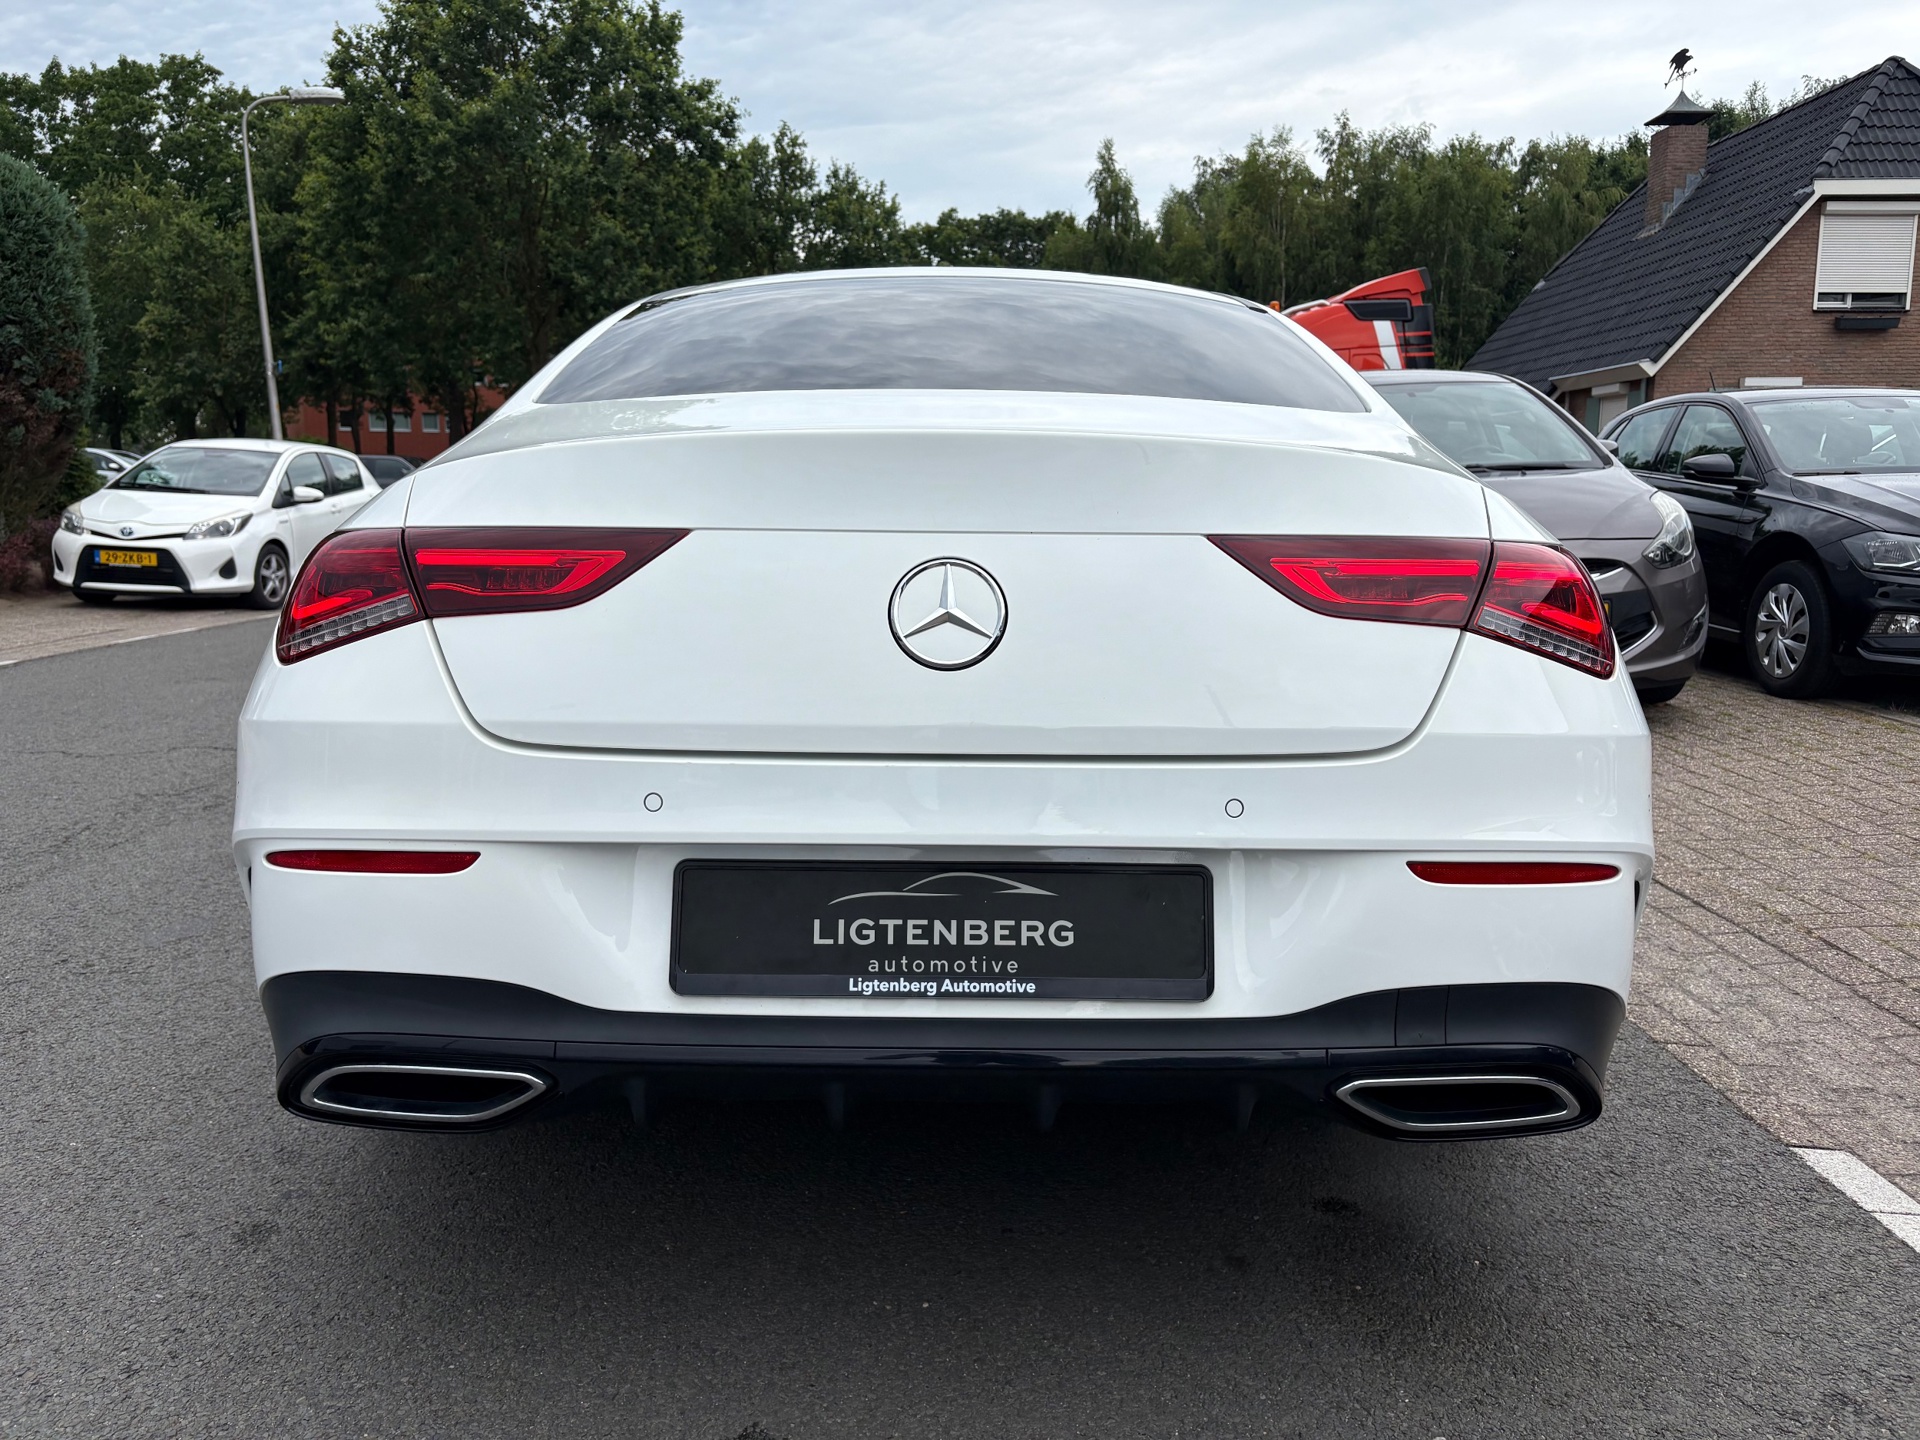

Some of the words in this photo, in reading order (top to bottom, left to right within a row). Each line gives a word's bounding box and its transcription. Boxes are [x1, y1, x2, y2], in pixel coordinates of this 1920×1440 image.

[105, 551, 152, 564] 29-ZKB-1
[813, 918, 1075, 947] LIGTENBERG
[868, 955, 1019, 973] automotive
[848, 978, 937, 996] Ligtenberg
[940, 979, 1036, 993] Automotive
